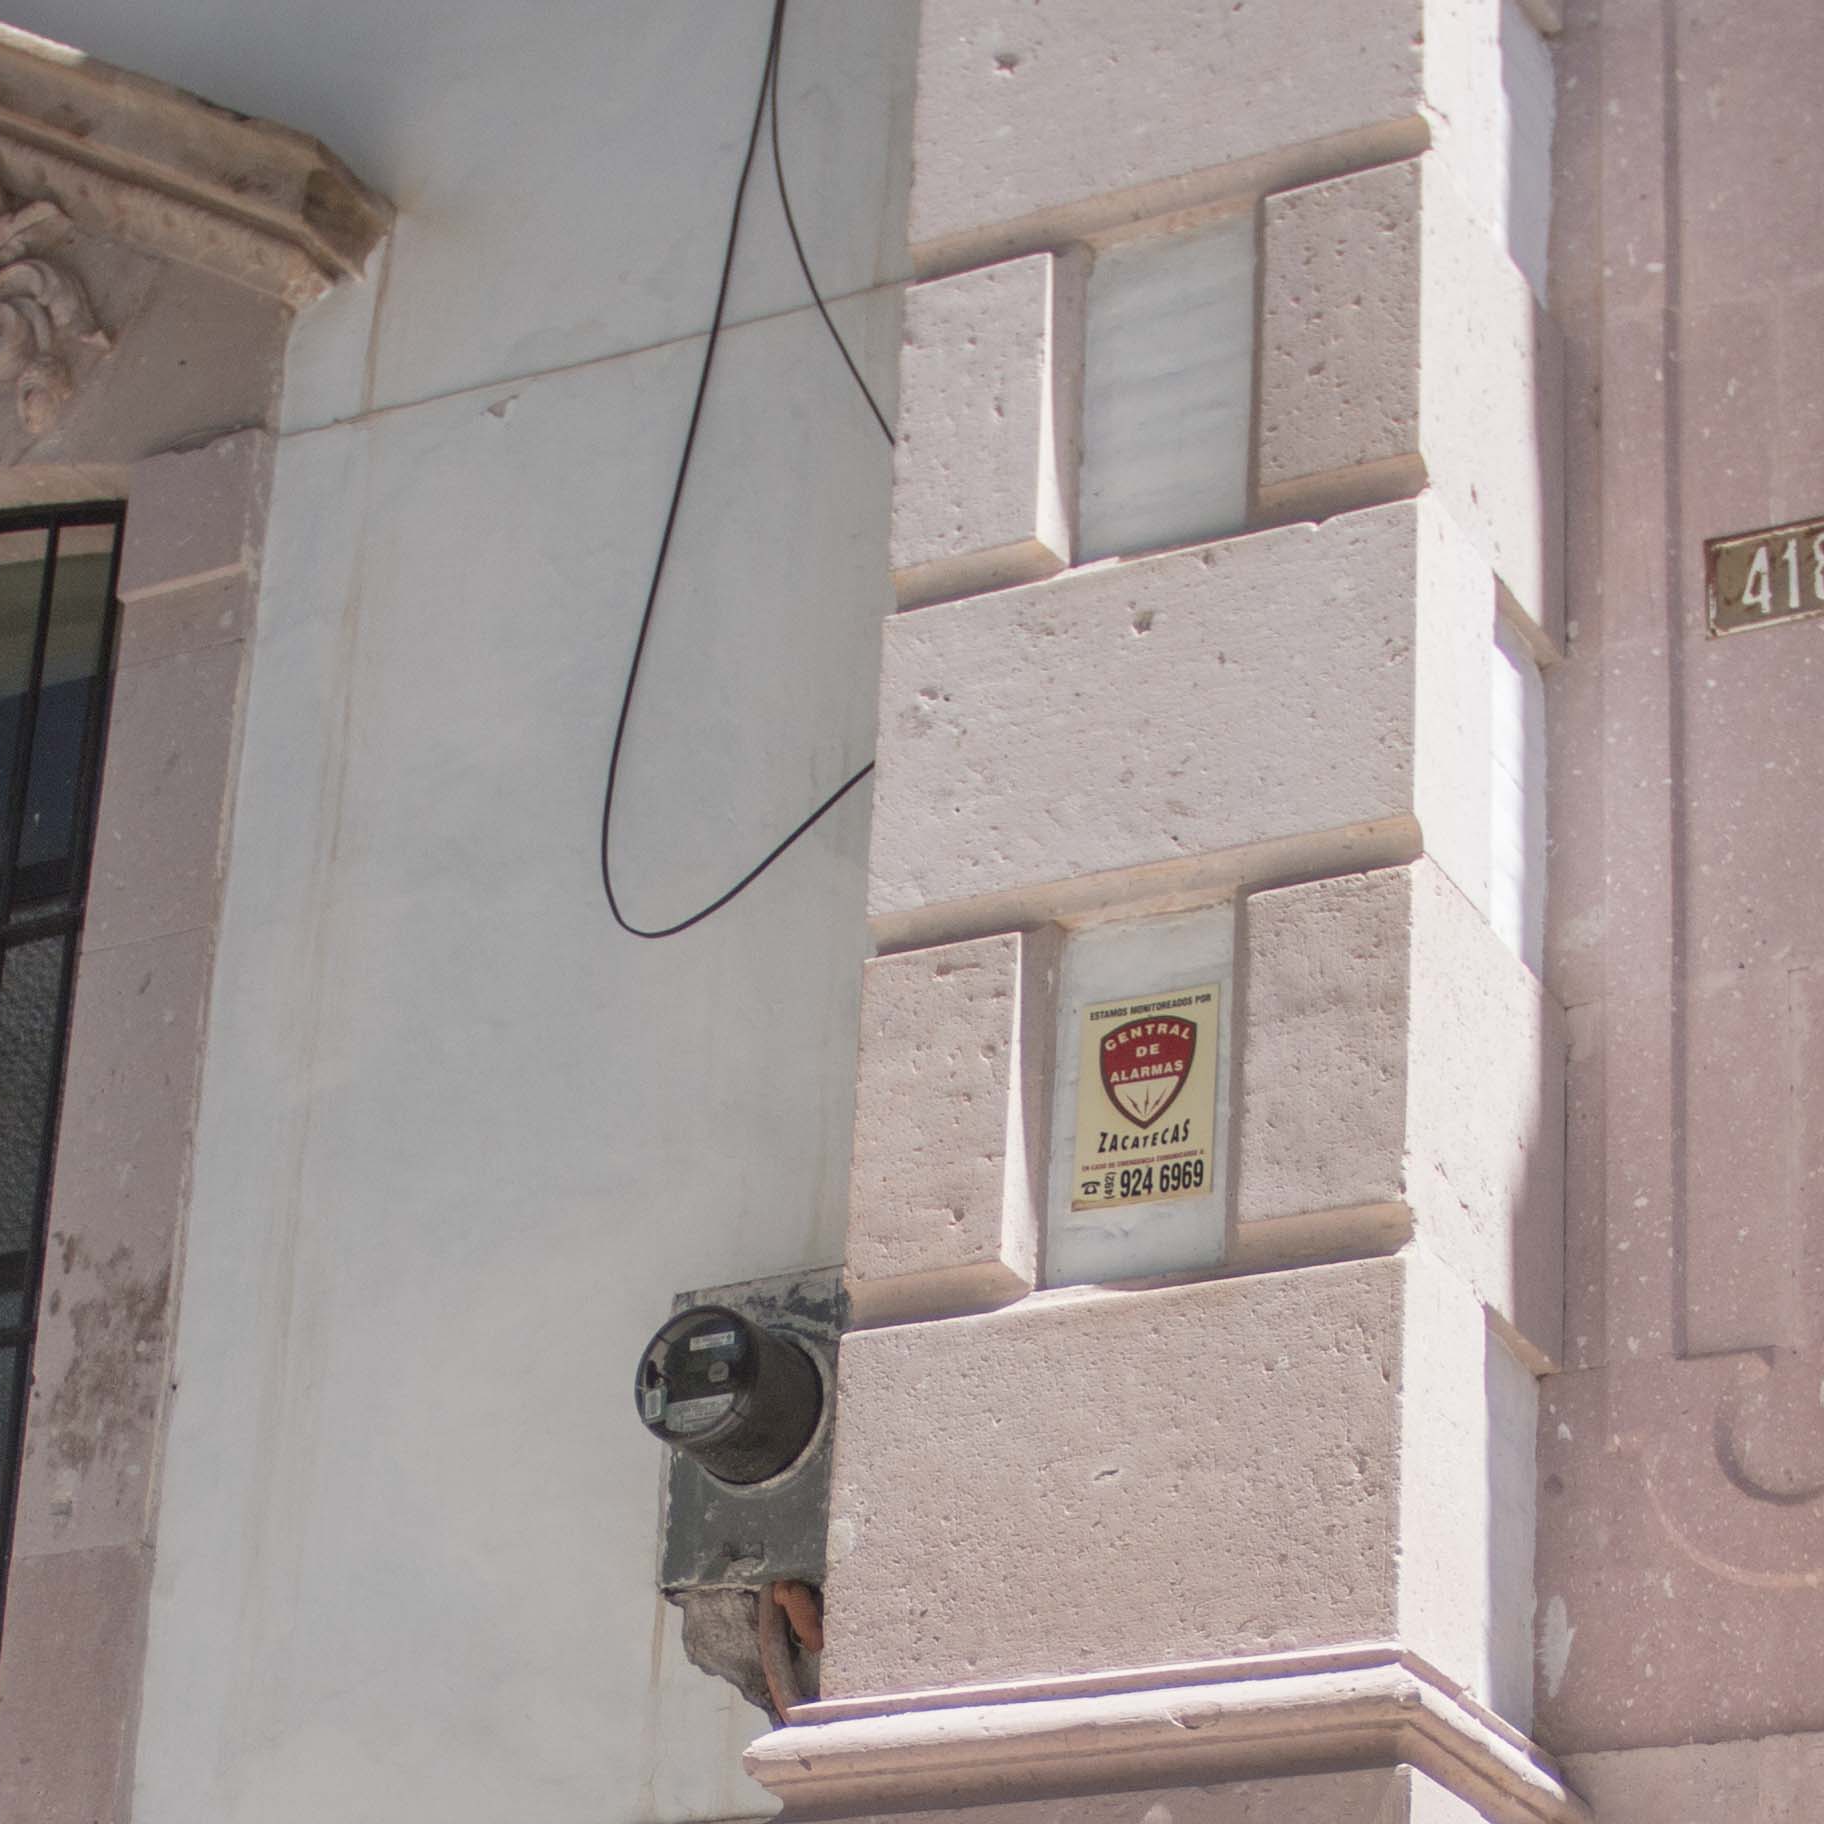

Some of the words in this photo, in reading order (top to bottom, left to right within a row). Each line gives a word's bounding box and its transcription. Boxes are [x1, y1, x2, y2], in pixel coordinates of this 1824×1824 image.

[1089, 1004, 1128, 1021] ESTAMOS
[1104, 1023, 1191, 1051] CENTRAL
[1135, 1043, 1160, 1057] DE
[1110, 1060, 1184, 1083] ALARMAS
[1097, 1118, 1191, 1154] ZACATECAS
[1120, 1166, 1153, 1198] 924
[1159, 1158, 1204, 1193] 6969
